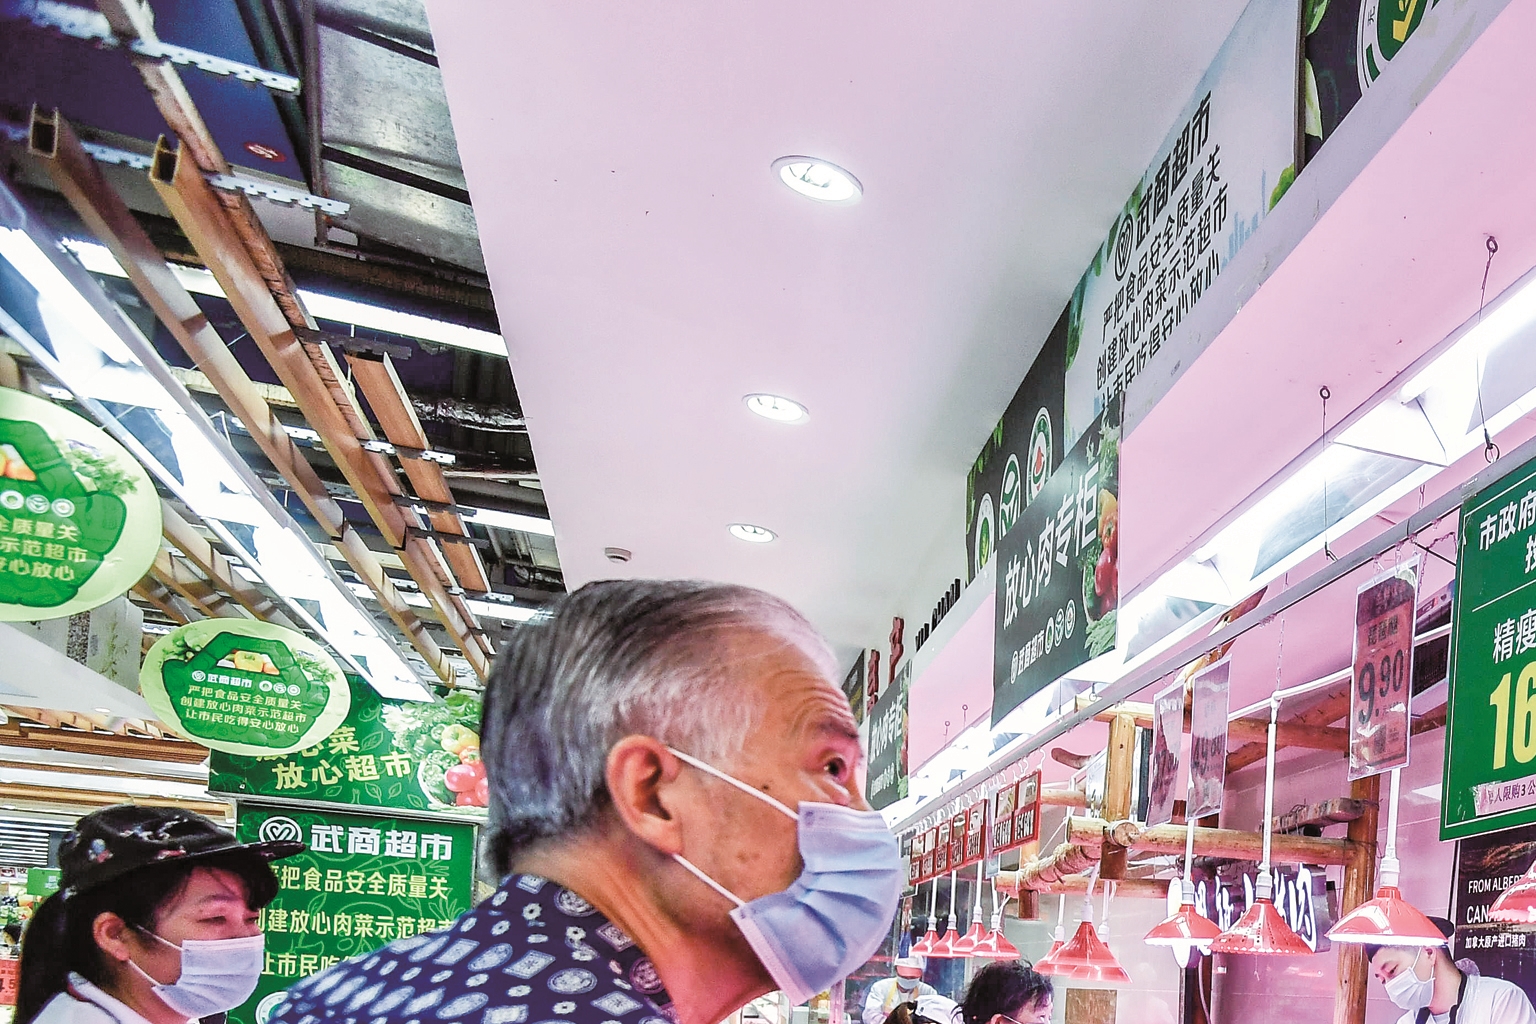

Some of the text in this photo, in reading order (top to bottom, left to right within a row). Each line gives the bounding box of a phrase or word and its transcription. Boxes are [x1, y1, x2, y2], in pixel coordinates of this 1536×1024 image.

[1134, 90, 1212, 251] 武商超市
[1101, 144, 1221, 345] 严把食品安全质量关
[1096, 183, 1229, 391] 创建放心肉菜示范超市
[1003, 461, 1099, 630] 放心肉专柜
[187, 684, 303, 711] 严把食品安全质量关
[207, 673, 253, 688] 武商超市
[1358, 648, 1405, 726] 9.90
[180, 696, 307, 723] 创建放心肉菜示范超市
[185, 708, 300, 734] 让市民吃得安心放心
[271, 751, 413, 790] 放心超市
[310, 824, 453, 861] 武商超市
[1468, 879, 1491, 894] FROM
[1465, 932, 1526, 949] 加拿大原产进口猪肉
